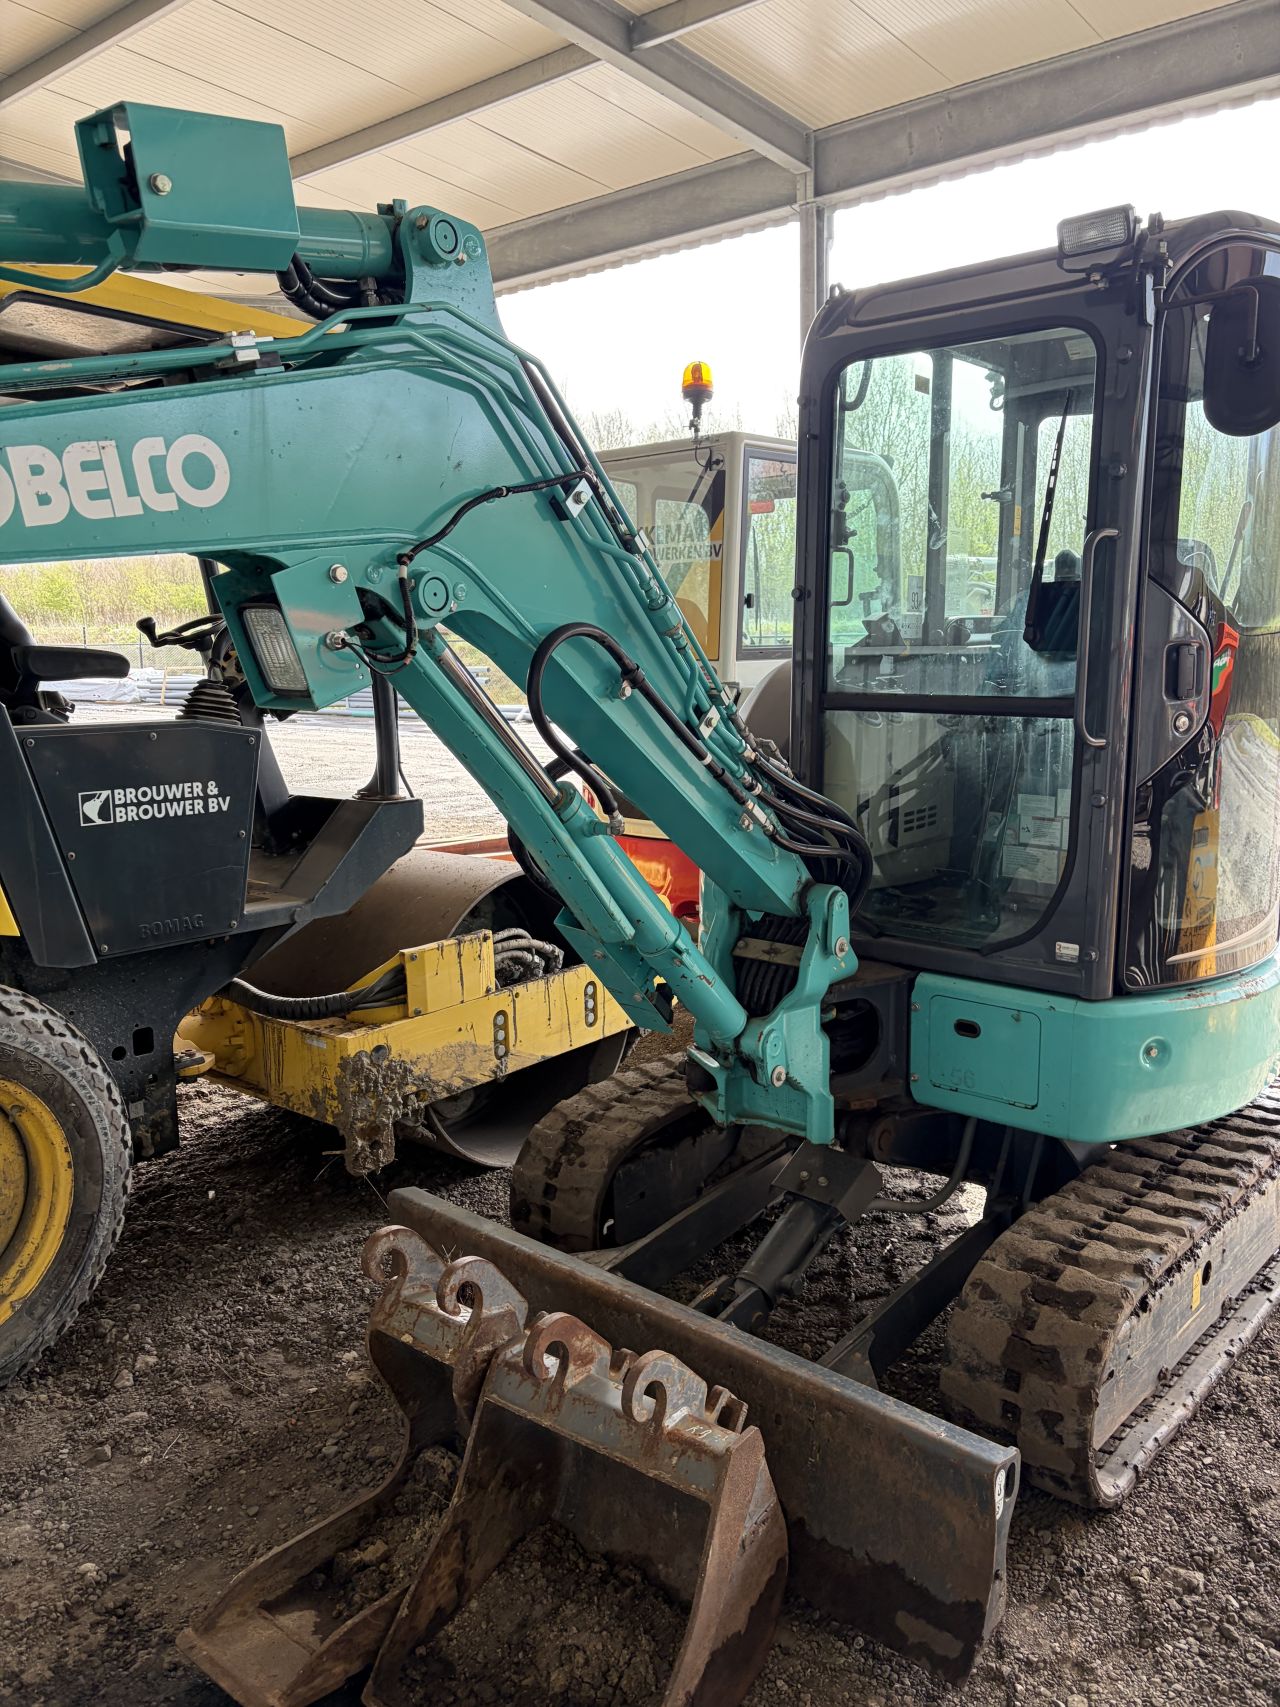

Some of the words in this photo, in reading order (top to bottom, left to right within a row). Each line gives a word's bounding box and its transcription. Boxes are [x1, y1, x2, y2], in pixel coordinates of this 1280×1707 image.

[0, 433, 230, 528] BELCO
[113, 781, 204, 805] BROUWER
[206, 780, 219, 795] &
[115, 798, 205, 823] BROUWER
[208, 796, 231, 813] BV
[137, 913, 205, 939] BOMAG
